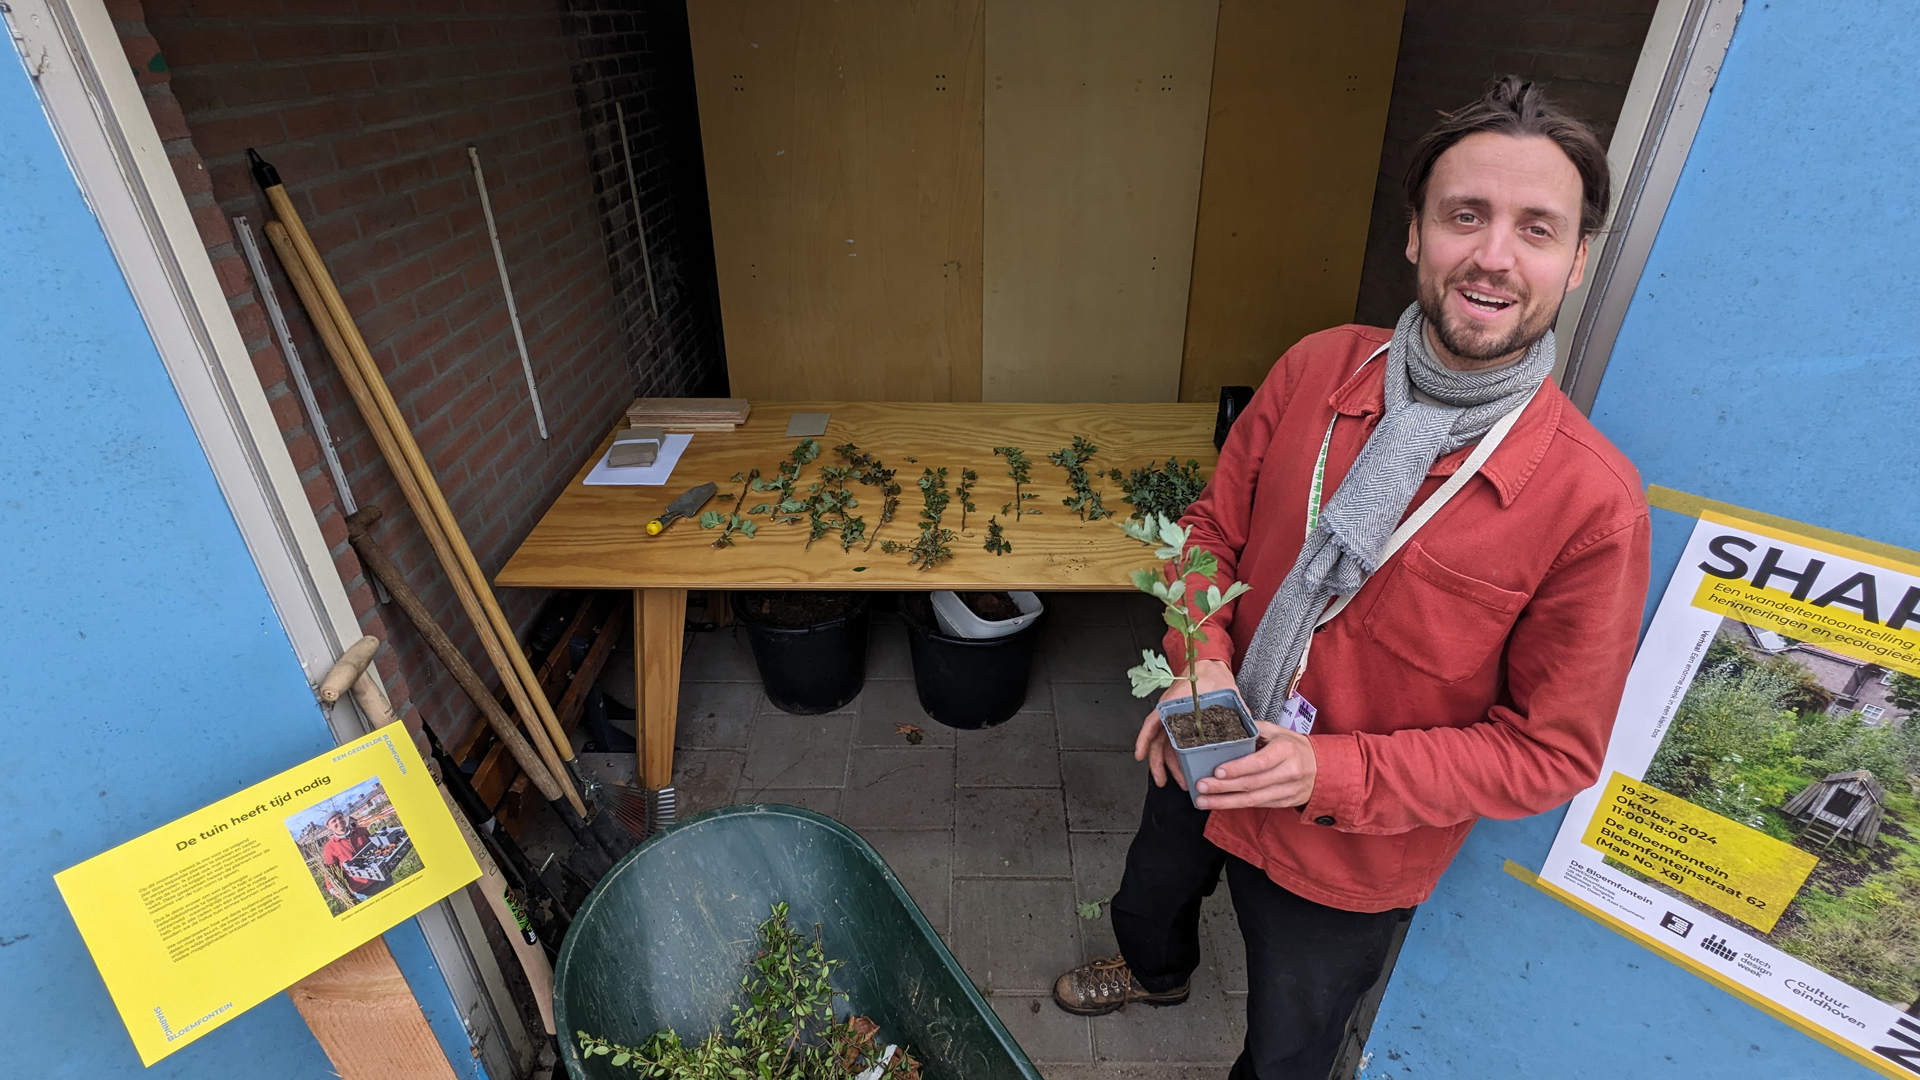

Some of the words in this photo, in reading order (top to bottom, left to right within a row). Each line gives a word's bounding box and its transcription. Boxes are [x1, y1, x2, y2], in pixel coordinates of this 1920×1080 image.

[1708, 593, 1808, 631] herinneringen
[1811, 625, 1831, 638] en
[1713, 582, 1741, 597] Een
[1744, 591, 1915, 650] wandeltentoonstelling
[1694, 630, 1710, 652] Verhaal
[1688, 652, 1699, 664] Een
[1677, 663, 1692, 685] enorme
[1670, 686, 1682, 700] bank
[1655, 715, 1667, 732] klein
[1662, 705, 1671, 716] een
[1651, 727, 1661, 739] bos
[332, 753, 347, 762] EEN
[347, 737, 382, 756] GEDEELDE
[383, 734, 407, 774] BLOEMFONTEIN
[1621, 784, 1659, 805] 19-27
[176, 838, 197, 851] De
[200, 822, 228, 840] tuin
[231, 804, 268, 827] heeft
[270, 792, 292, 808] tijd
[295, 775, 332, 797] nodig
[1611, 804, 1688, 844] 11:00-18:00
[1616, 795, 1677, 826] Oktober
[1679, 823, 1718, 846] 2024
[1596, 836, 1630, 858] (Map
[1633, 853, 1655, 871] No.
[1659, 867, 1685, 885] X8)
[1605, 817, 1625, 831] De
[1628, 829, 1729, 880] Bloemfontein
[1570, 860, 1584, 870] De
[1586, 868, 1653, 906] Bloemfontein
[1600, 827, 1743, 899] Bloemfonteinstraat
[1746, 896, 1767, 910] 62
[1738, 962, 1762, 978] week
[1740, 957, 1772, 976] design
[1744, 952, 1771, 969] dutch
[1792, 988, 1866, 1028] eindhoven
[1798, 981, 1850, 1010] cultuur
[154, 1006, 172, 1037] SHARING
[167, 1002, 233, 1042] BLOEMFONTEIN
